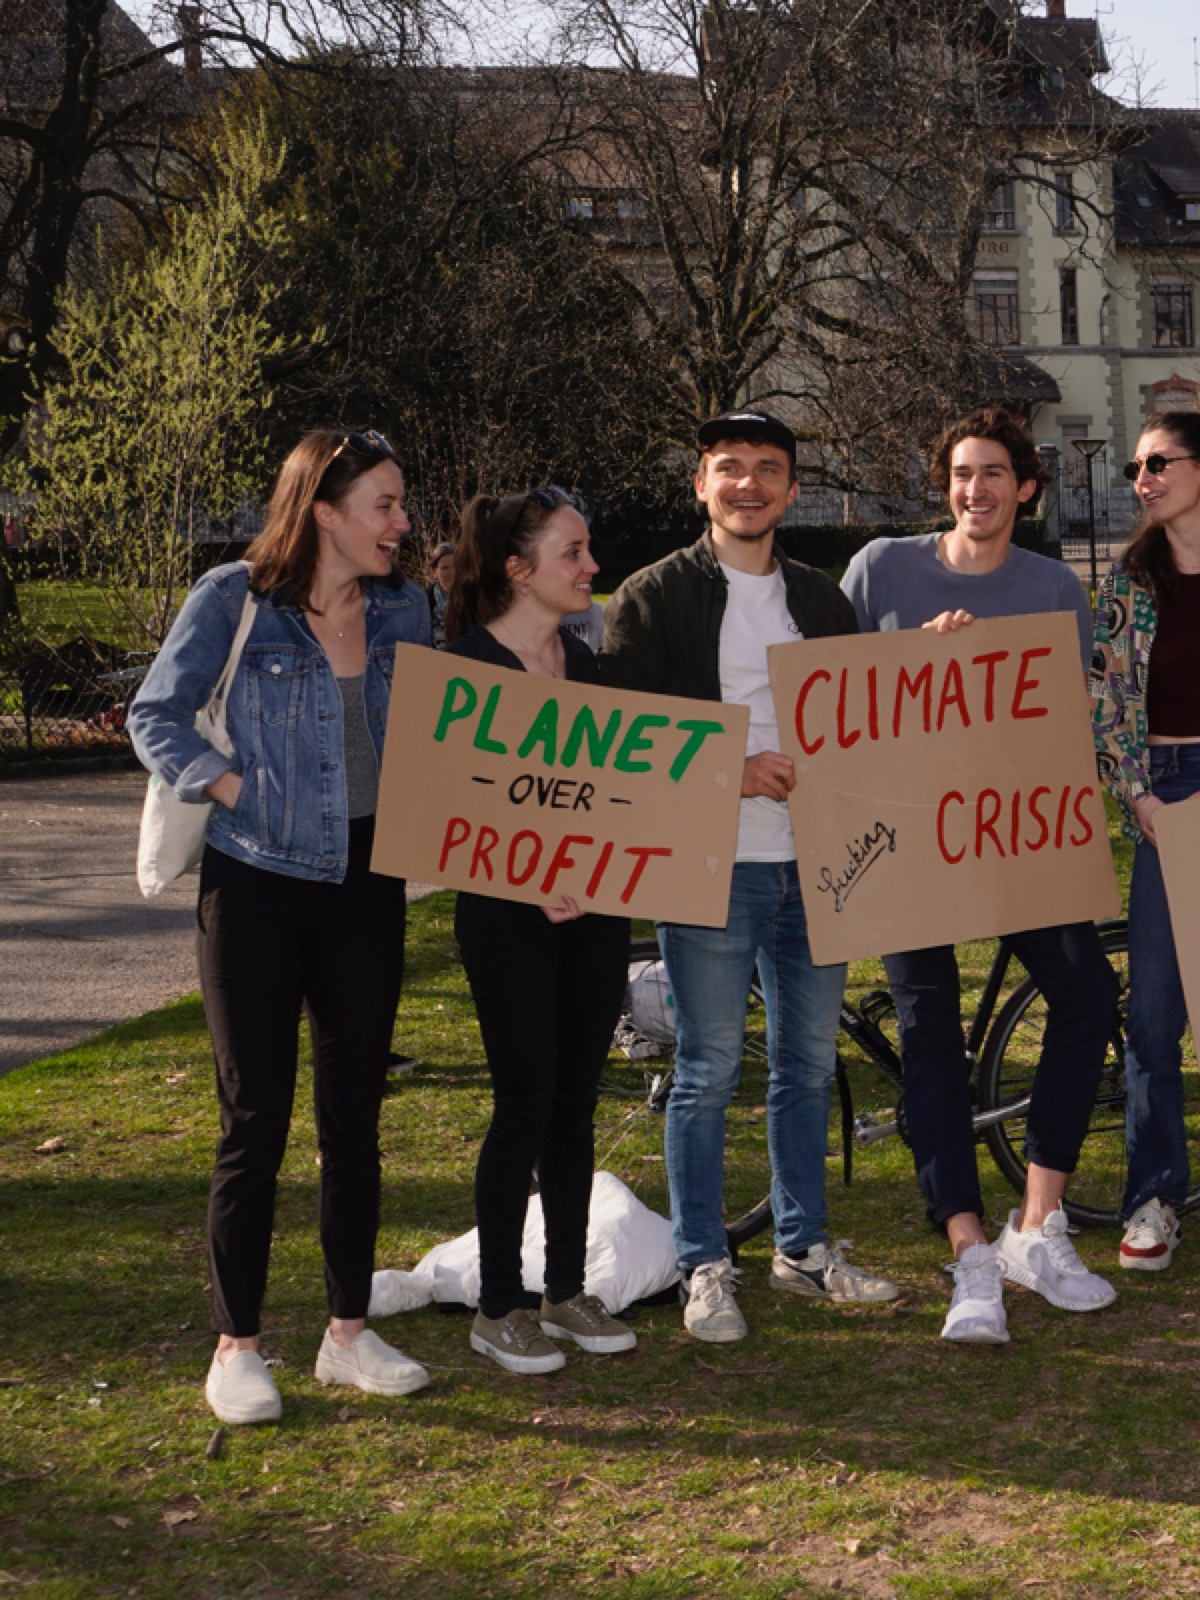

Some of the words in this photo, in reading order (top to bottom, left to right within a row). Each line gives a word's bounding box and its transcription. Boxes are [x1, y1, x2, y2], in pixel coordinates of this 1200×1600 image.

[433, 677, 724, 783] PLANET
[795, 647, 1052, 755] CLIMATE
[508, 773, 595, 811] OVER
[937, 785, 1094, 864] CRISIS
[439, 817, 673, 904] PROFIT
